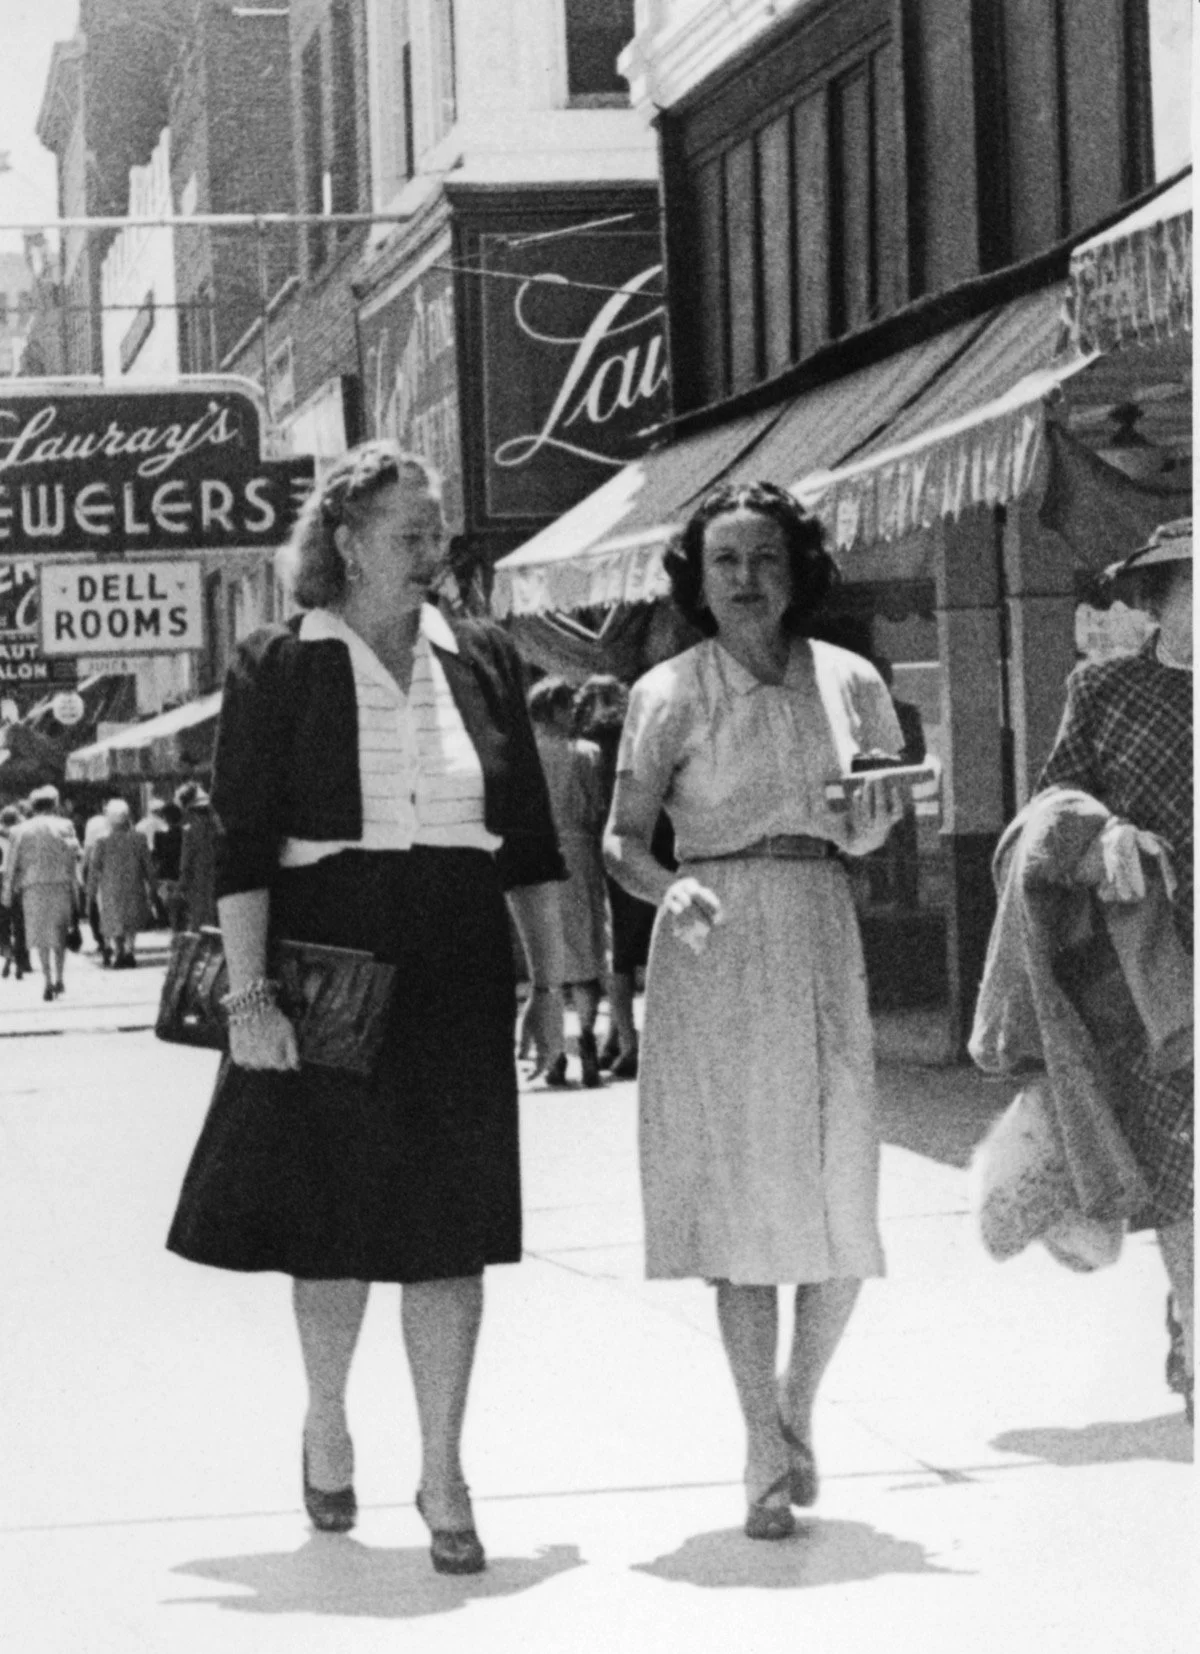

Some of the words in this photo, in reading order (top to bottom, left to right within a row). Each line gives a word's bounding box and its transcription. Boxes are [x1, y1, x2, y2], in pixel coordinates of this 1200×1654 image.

[495, 264, 668, 466] Lau
[78, 574, 167, 602] DELL
[55, 606, 188, 640] ROOMS
